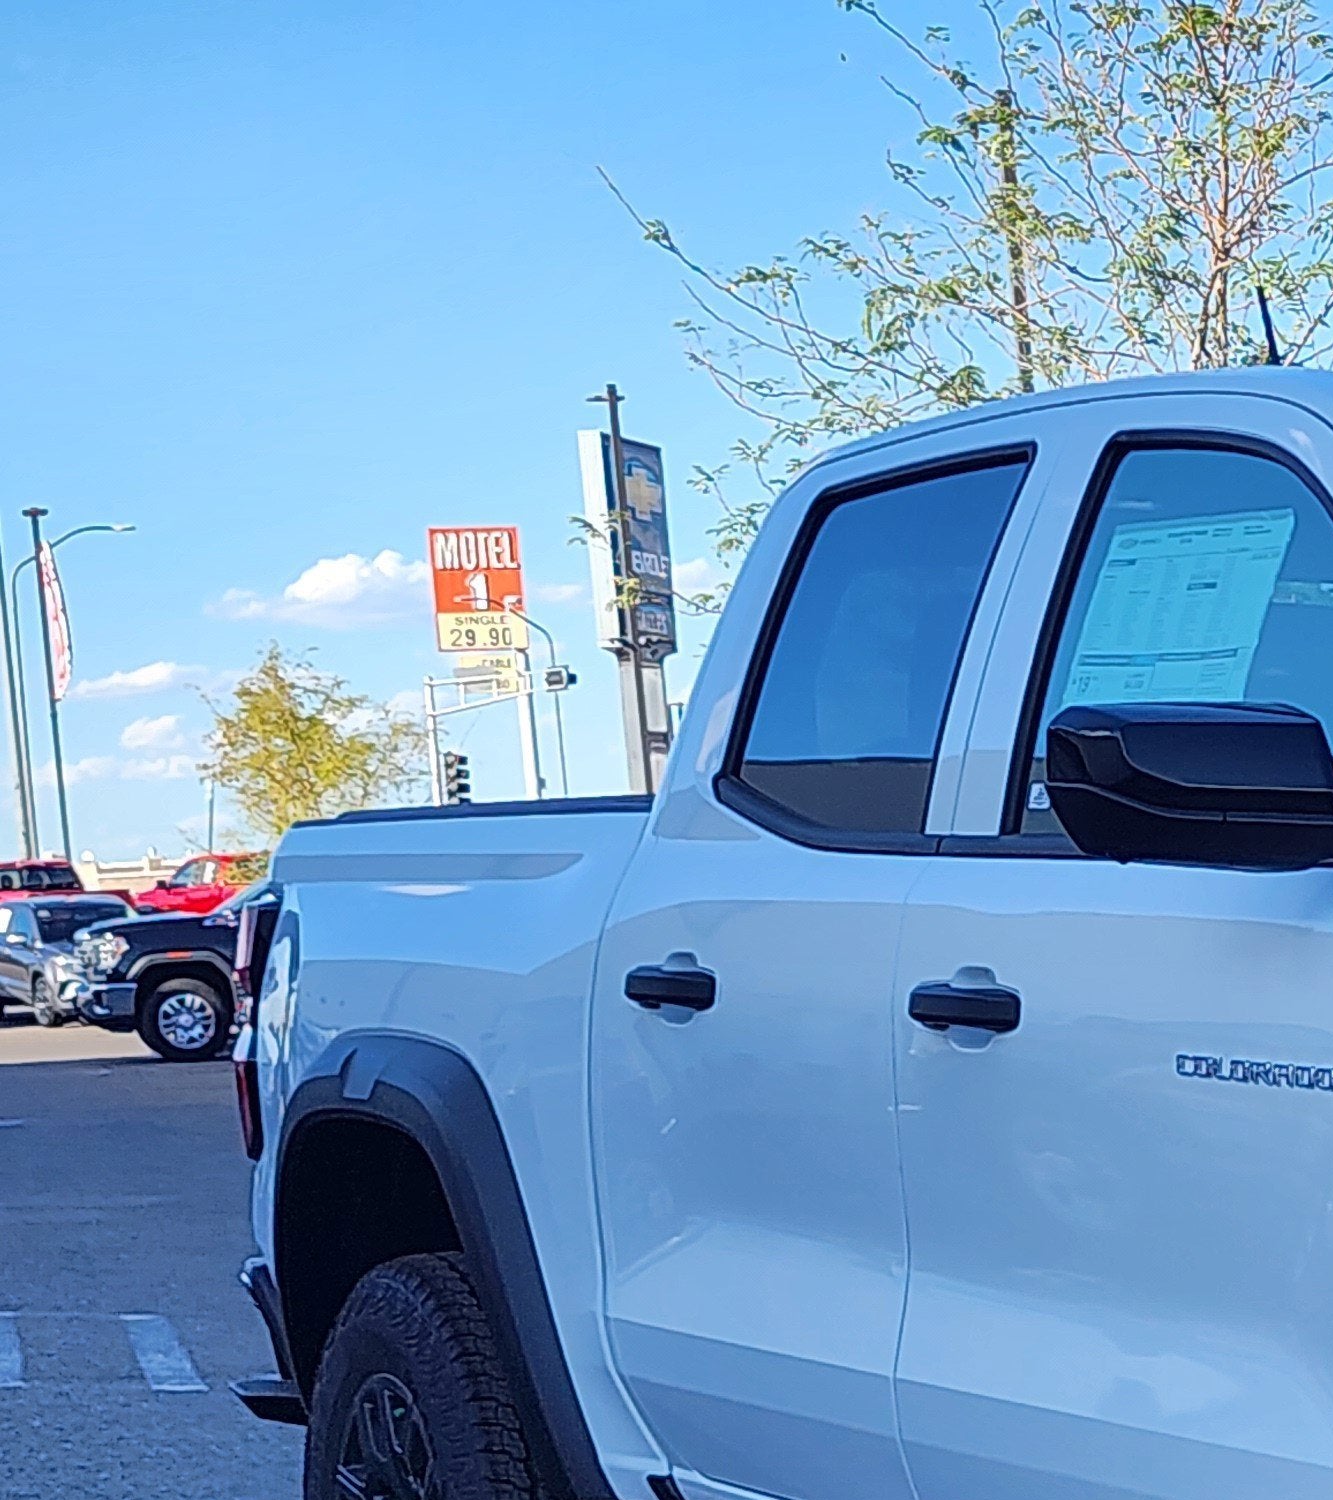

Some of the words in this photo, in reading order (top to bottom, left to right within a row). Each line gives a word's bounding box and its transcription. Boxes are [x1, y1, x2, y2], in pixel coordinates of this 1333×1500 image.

[433, 531, 518, 569] MOTEL
[455, 615, 509, 626] SINGLE
[450, 627, 512, 647] 29.90
